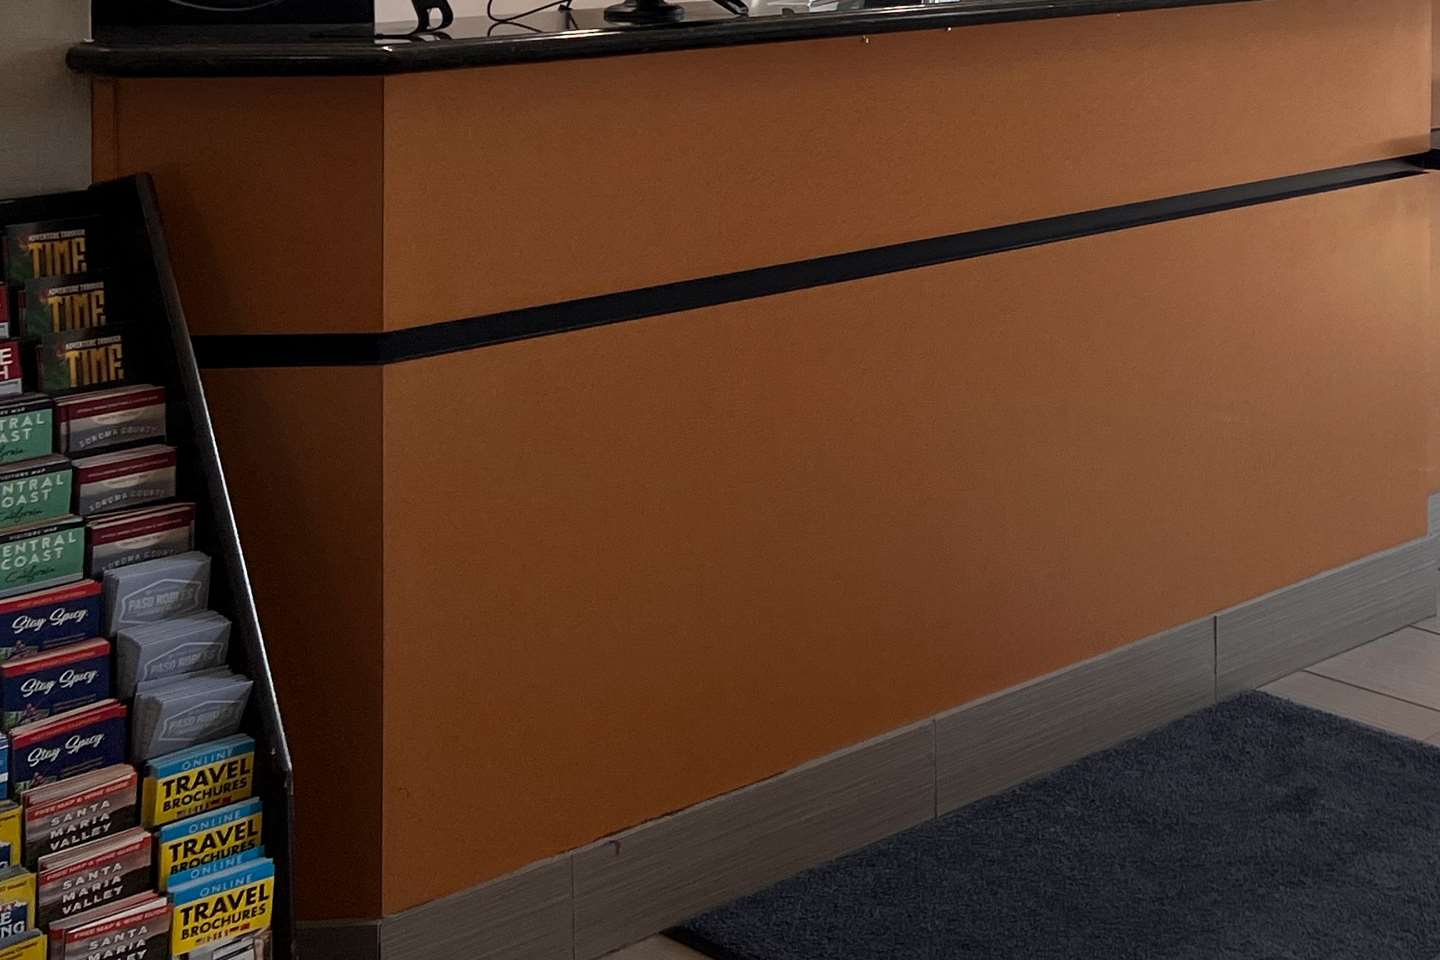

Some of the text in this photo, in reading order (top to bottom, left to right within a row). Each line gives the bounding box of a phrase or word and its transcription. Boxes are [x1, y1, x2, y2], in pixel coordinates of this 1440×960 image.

[29, 237, 88, 279] TIME
[48, 290, 107, 333] TIME
[65, 344, 125, 388] TIME
[0, 414, 45, 432] TRAL
[0, 428, 33, 443] AST
[1, 488, 52, 508] OAST
[2, 474, 64, 496] NTRAL
[1, 546, 65, 571] COAST
[2, 531, 77, 558] ENTRAL
[11, 615, 47, 635] Stay
[20, 678, 57, 698] Stay
[27, 747, 62, 768] Stay
[182, 748, 234, 771] ONLINE
[162, 758, 250, 799] TRAVEL
[163, 777, 248, 812] BROCHURES
[50, 799, 111, 827] SANTA
[50, 812, 111, 840] MARIA
[188, 809, 242, 834] ONLINE
[49, 822, 112, 851] VALLEY
[168, 818, 258, 863] TRAVEL
[170, 838, 255, 875] BROCHURES
[62, 862, 123, 891] SANTA
[62, 875, 122, 903] MARIA
[199, 872, 254, 898] ONLINE
[61, 885, 124, 915] VALLEY
[180, 883, 270, 926] TRAVEL
[181, 902, 266, 940] BROCHURES
[87, 938, 147, 960] MARIA
[88, 925, 148, 951] SANTA
